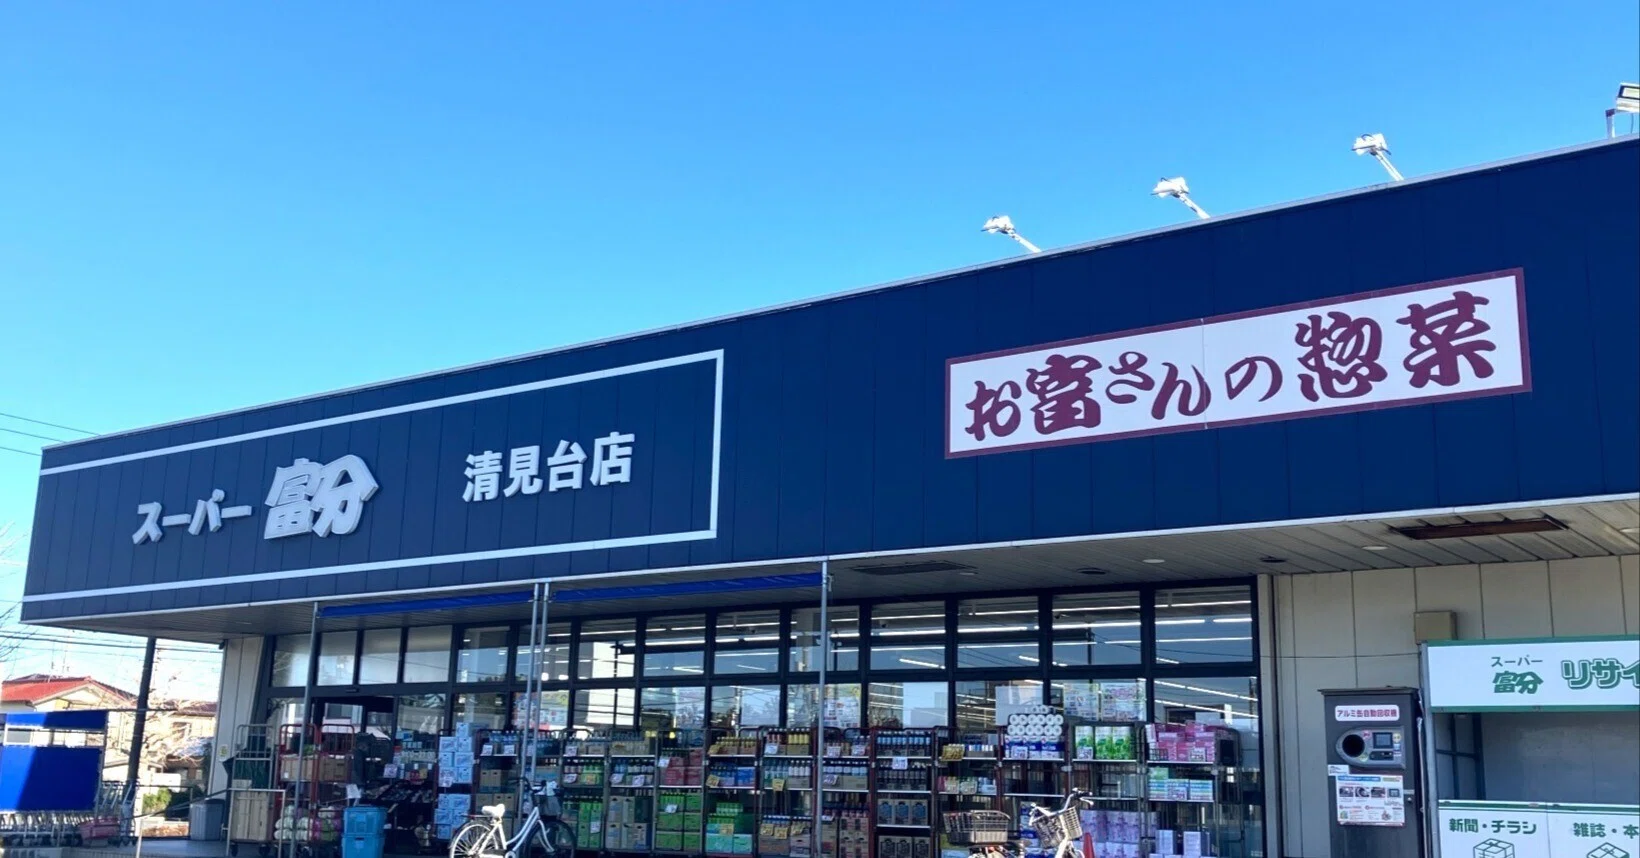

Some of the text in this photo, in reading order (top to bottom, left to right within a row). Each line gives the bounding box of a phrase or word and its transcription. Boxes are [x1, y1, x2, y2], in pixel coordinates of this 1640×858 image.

[965, 291, 1497, 442] お富さんの惣菜
[462, 431, 636, 502] 清見台店
[132, 454, 380, 544] スーパー 富分
[1491, 655, 1543, 667] スーパー
[1449, 818, 1537, 835] 新聞・チラシ
[1573, 822, 1640, 839] 雑誌・本
